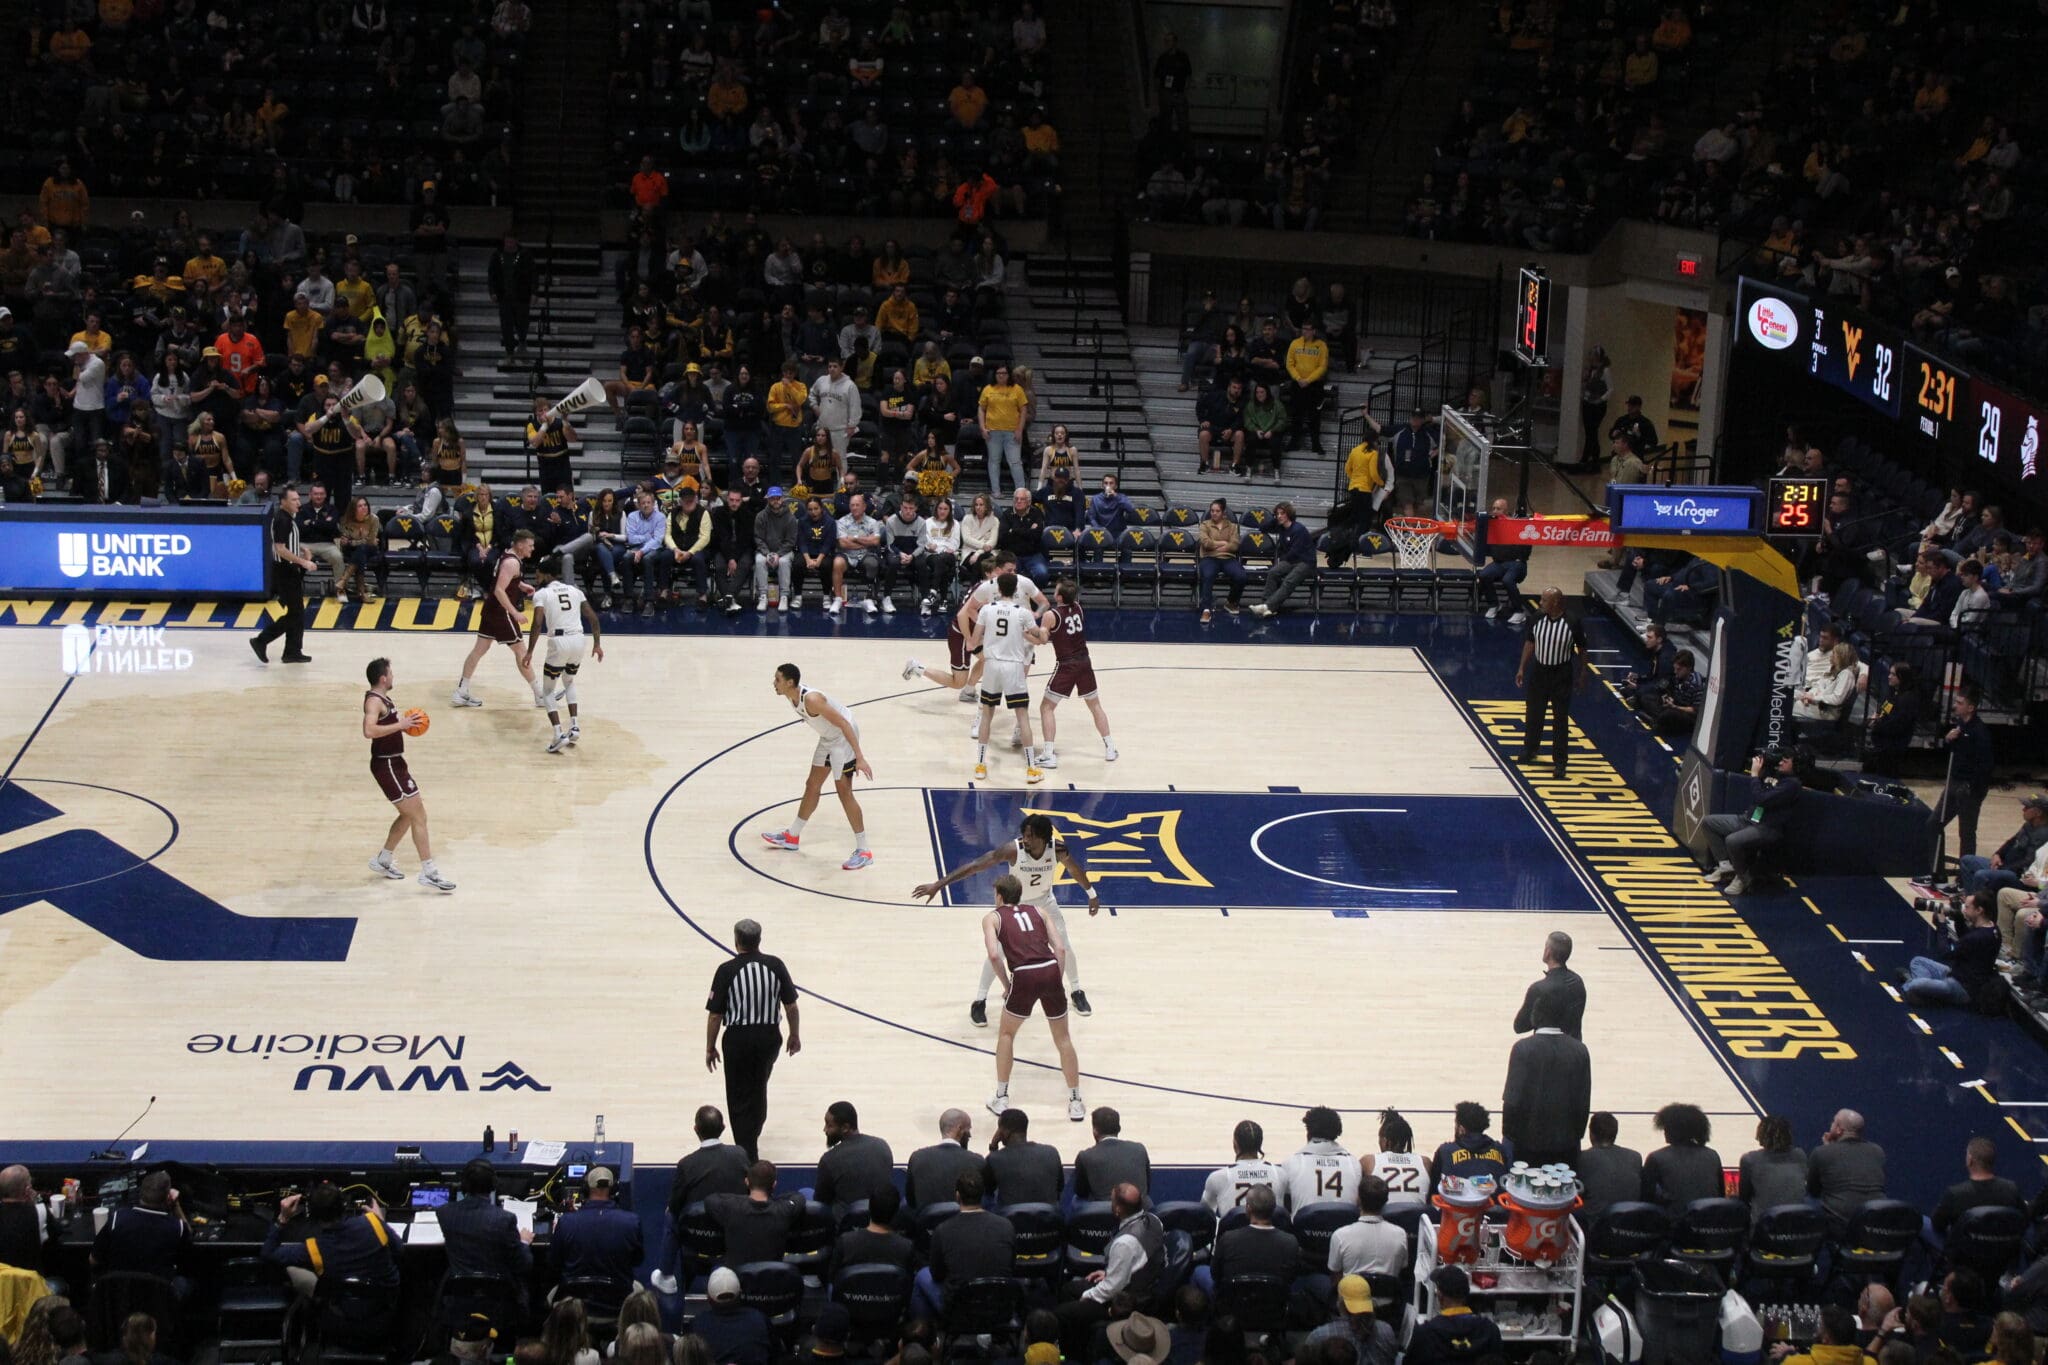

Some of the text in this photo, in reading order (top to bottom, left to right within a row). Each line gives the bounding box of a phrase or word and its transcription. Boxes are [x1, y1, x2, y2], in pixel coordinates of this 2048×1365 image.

[1681, 260, 1697, 274] EXIT
[1757, 304, 1774, 321] Little
[1760, 318, 1788, 336] General
[1815, 319, 1821, 340] 3
[1811, 342, 1828, 356] FOULS
[230, 353, 242, 372] 9
[1811, 353, 1818, 373] 3
[1873, 344, 1892, 401] 32
[340, 389, 363, 408] WVU
[1918, 362, 1955, 422] 2:31
[556, 393, 587, 414] WVU
[1979, 401, 2001, 463] 29
[1784, 486, 1818, 502] 2:31
[1674, 498, 1719, 524] Kroger
[1779, 505, 1809, 526] 25
[92, 534, 192, 555] UNITED
[92, 555, 164, 577] BANK
[558, 593, 572, 611] 5
[995, 617, 1009, 637] 9
[1064, 613, 1083, 635] 33
[1767, 682, 1788, 750] Medicine
[1509, 753, 1680, 848] VIRGINIA
[1029, 873, 1042, 888] 2
[1013, 911, 1035, 932] 11
[1585, 855, 1858, 1060] MOUNTAINEERS
[187, 1033, 466, 1060] Medicine
[293, 1065, 470, 1091] WVU
[1316, 1158, 1340, 1167] WILSON
[1388, 1155, 1411, 1164] HARRIS
[1452, 1149, 1471, 1165] WEST
[1237, 1170, 1268, 1179] SUEMNICH
[1315, 1169, 1343, 1198] 14
[1382, 1167, 1419, 1193] 22
[1457, 1218, 1475, 1237] G
[1539, 1219, 1557, 1238] G
